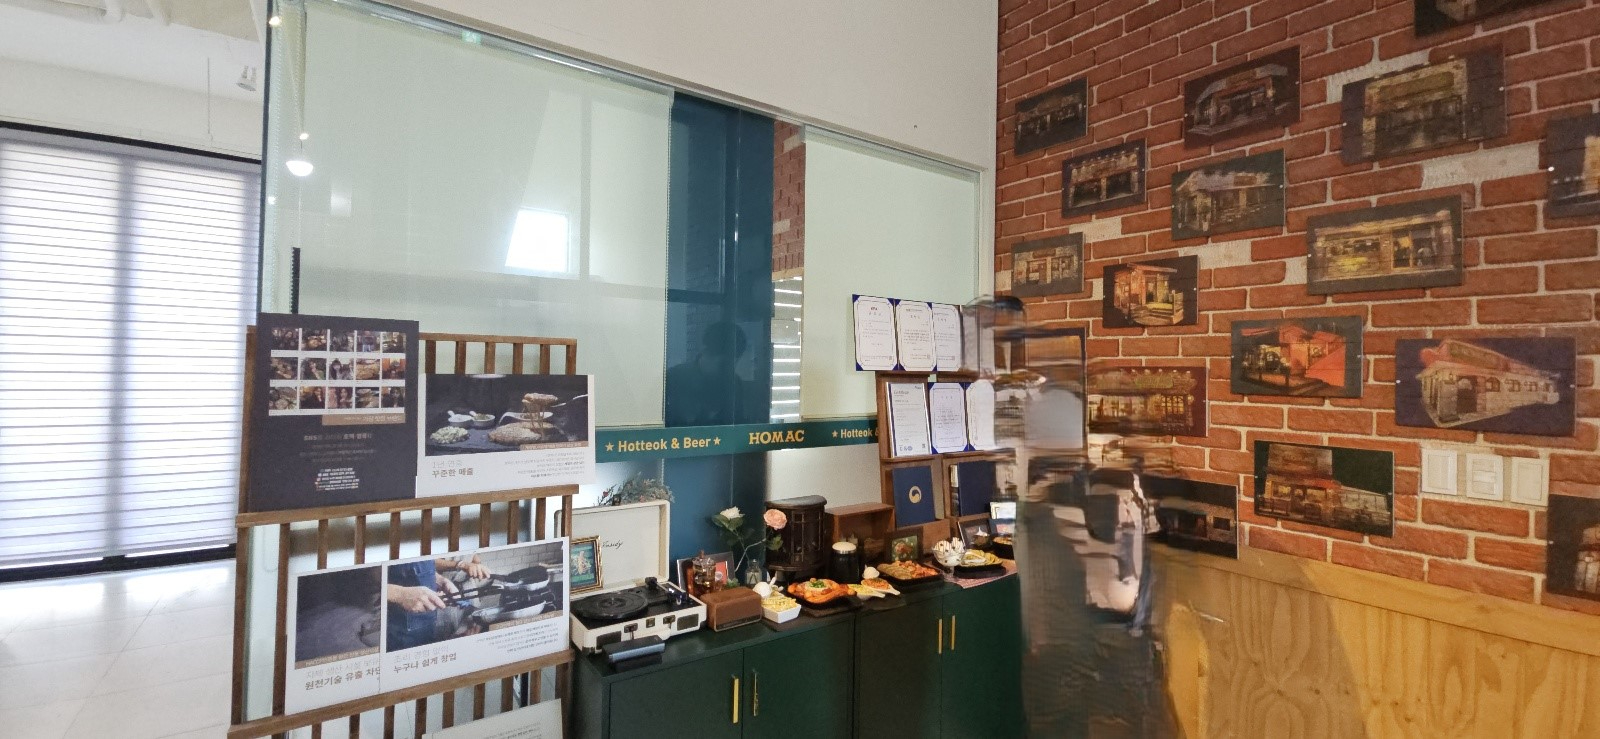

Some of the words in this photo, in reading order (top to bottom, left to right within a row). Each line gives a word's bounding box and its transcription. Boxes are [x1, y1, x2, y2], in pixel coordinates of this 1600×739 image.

[749, 430, 804, 445] HOMAC
[840, 428, 873, 439] Hotteok
[618, 439, 668, 452] Hotteok
[670, 437, 680, 449] &
[683, 437, 711, 448] Beer
[432, 469, 456, 478] 꾸준한
[458, 467, 474, 476] 매출
[393, 660, 419, 674] 누구나
[421, 656, 438, 668] 쉽게
[441, 652, 457, 663] 창업
[305, 675, 342, 691] 원천기술
[345, 670, 363, 682] 유출
